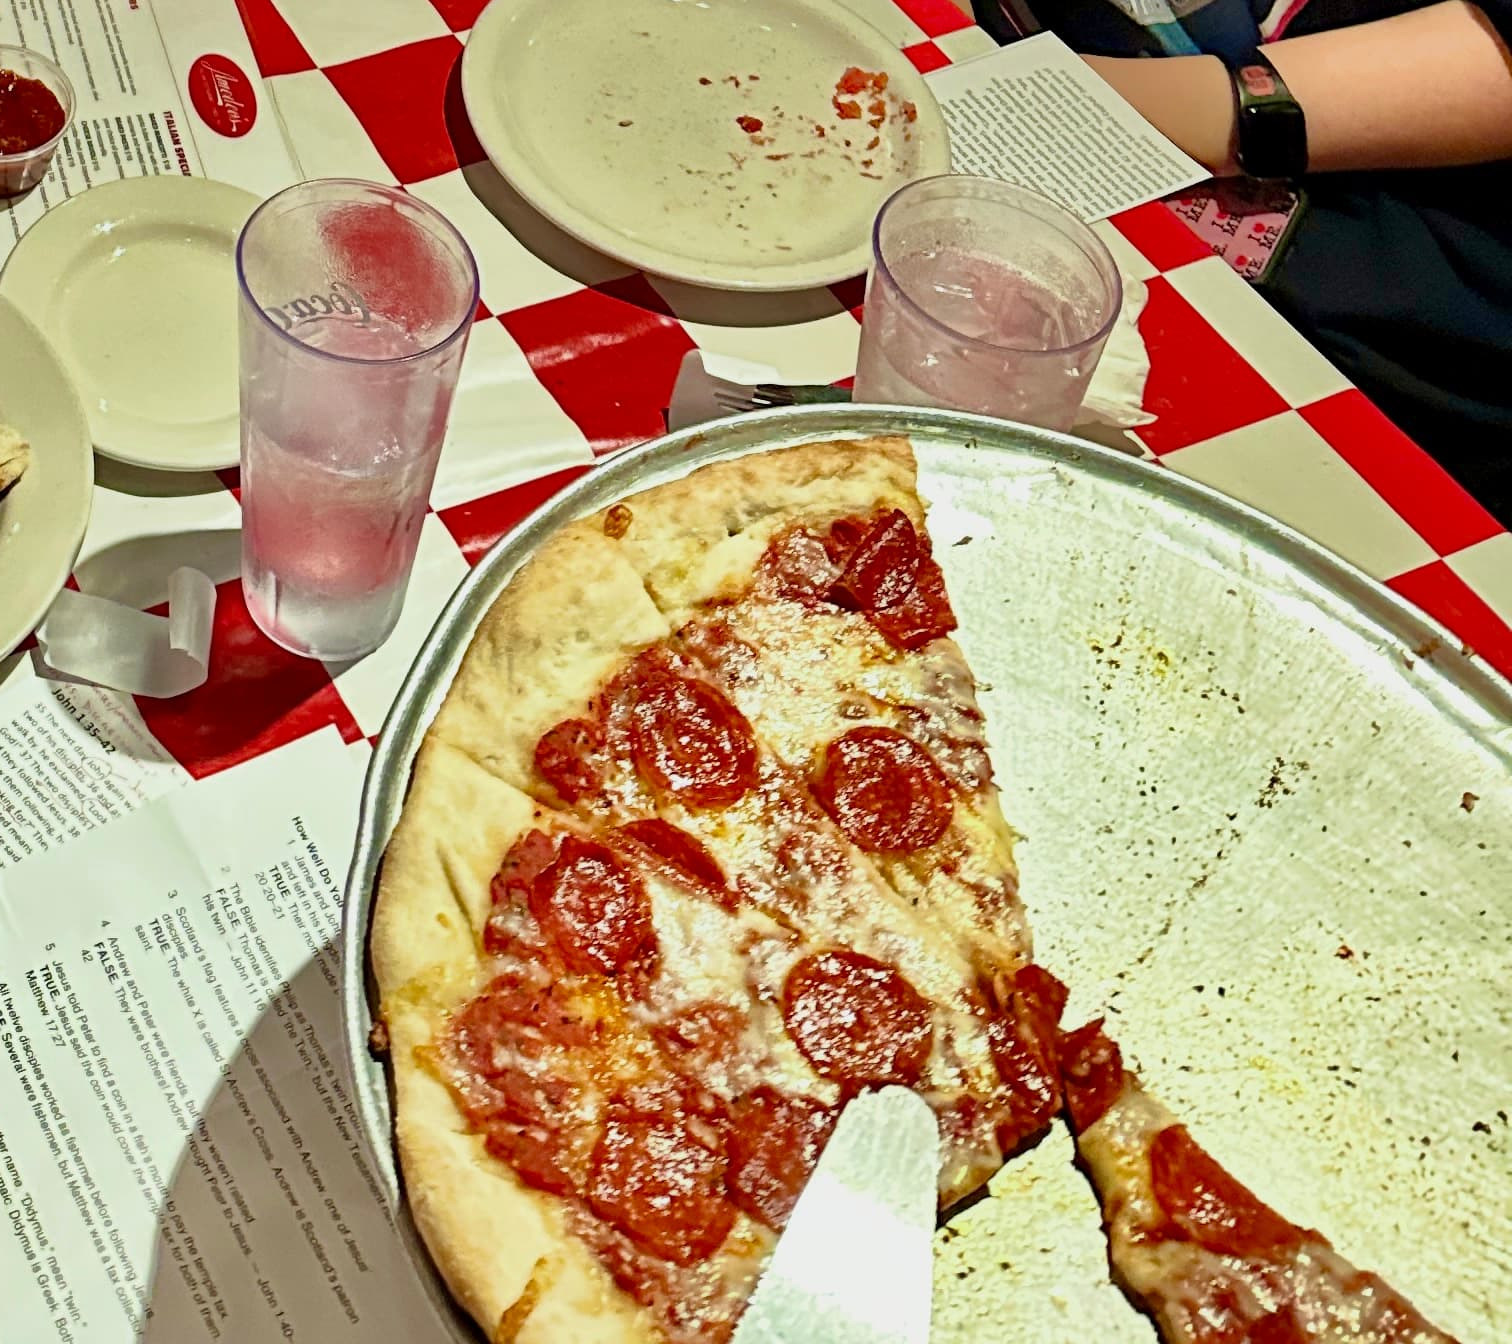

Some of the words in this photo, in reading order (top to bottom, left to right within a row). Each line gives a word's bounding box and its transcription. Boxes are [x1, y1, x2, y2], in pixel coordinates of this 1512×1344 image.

[163, 111, 181, 146] ITALIAN
[51, 688, 77, 716] John
[1, 750, 17, 770] they
[17, 768, 50, 803] followed
[3, 775, 23, 797] them
[3, 845, 22, 863] said
[291, 816, 309, 841] How
[306, 841, 325, 867] Well
[318, 868, 332, 885] Do
[3, 997, 24, 1033] twelve
[18, 1035, 45, 1081] disciples
[40, 1081, 65, 1121] worked
[58, 1122, 70, 1136] as
[65, 1136, 95, 1190] fishermen
[90, 1190, 112, 1227] before
[108, 1229, 137, 1282] following
